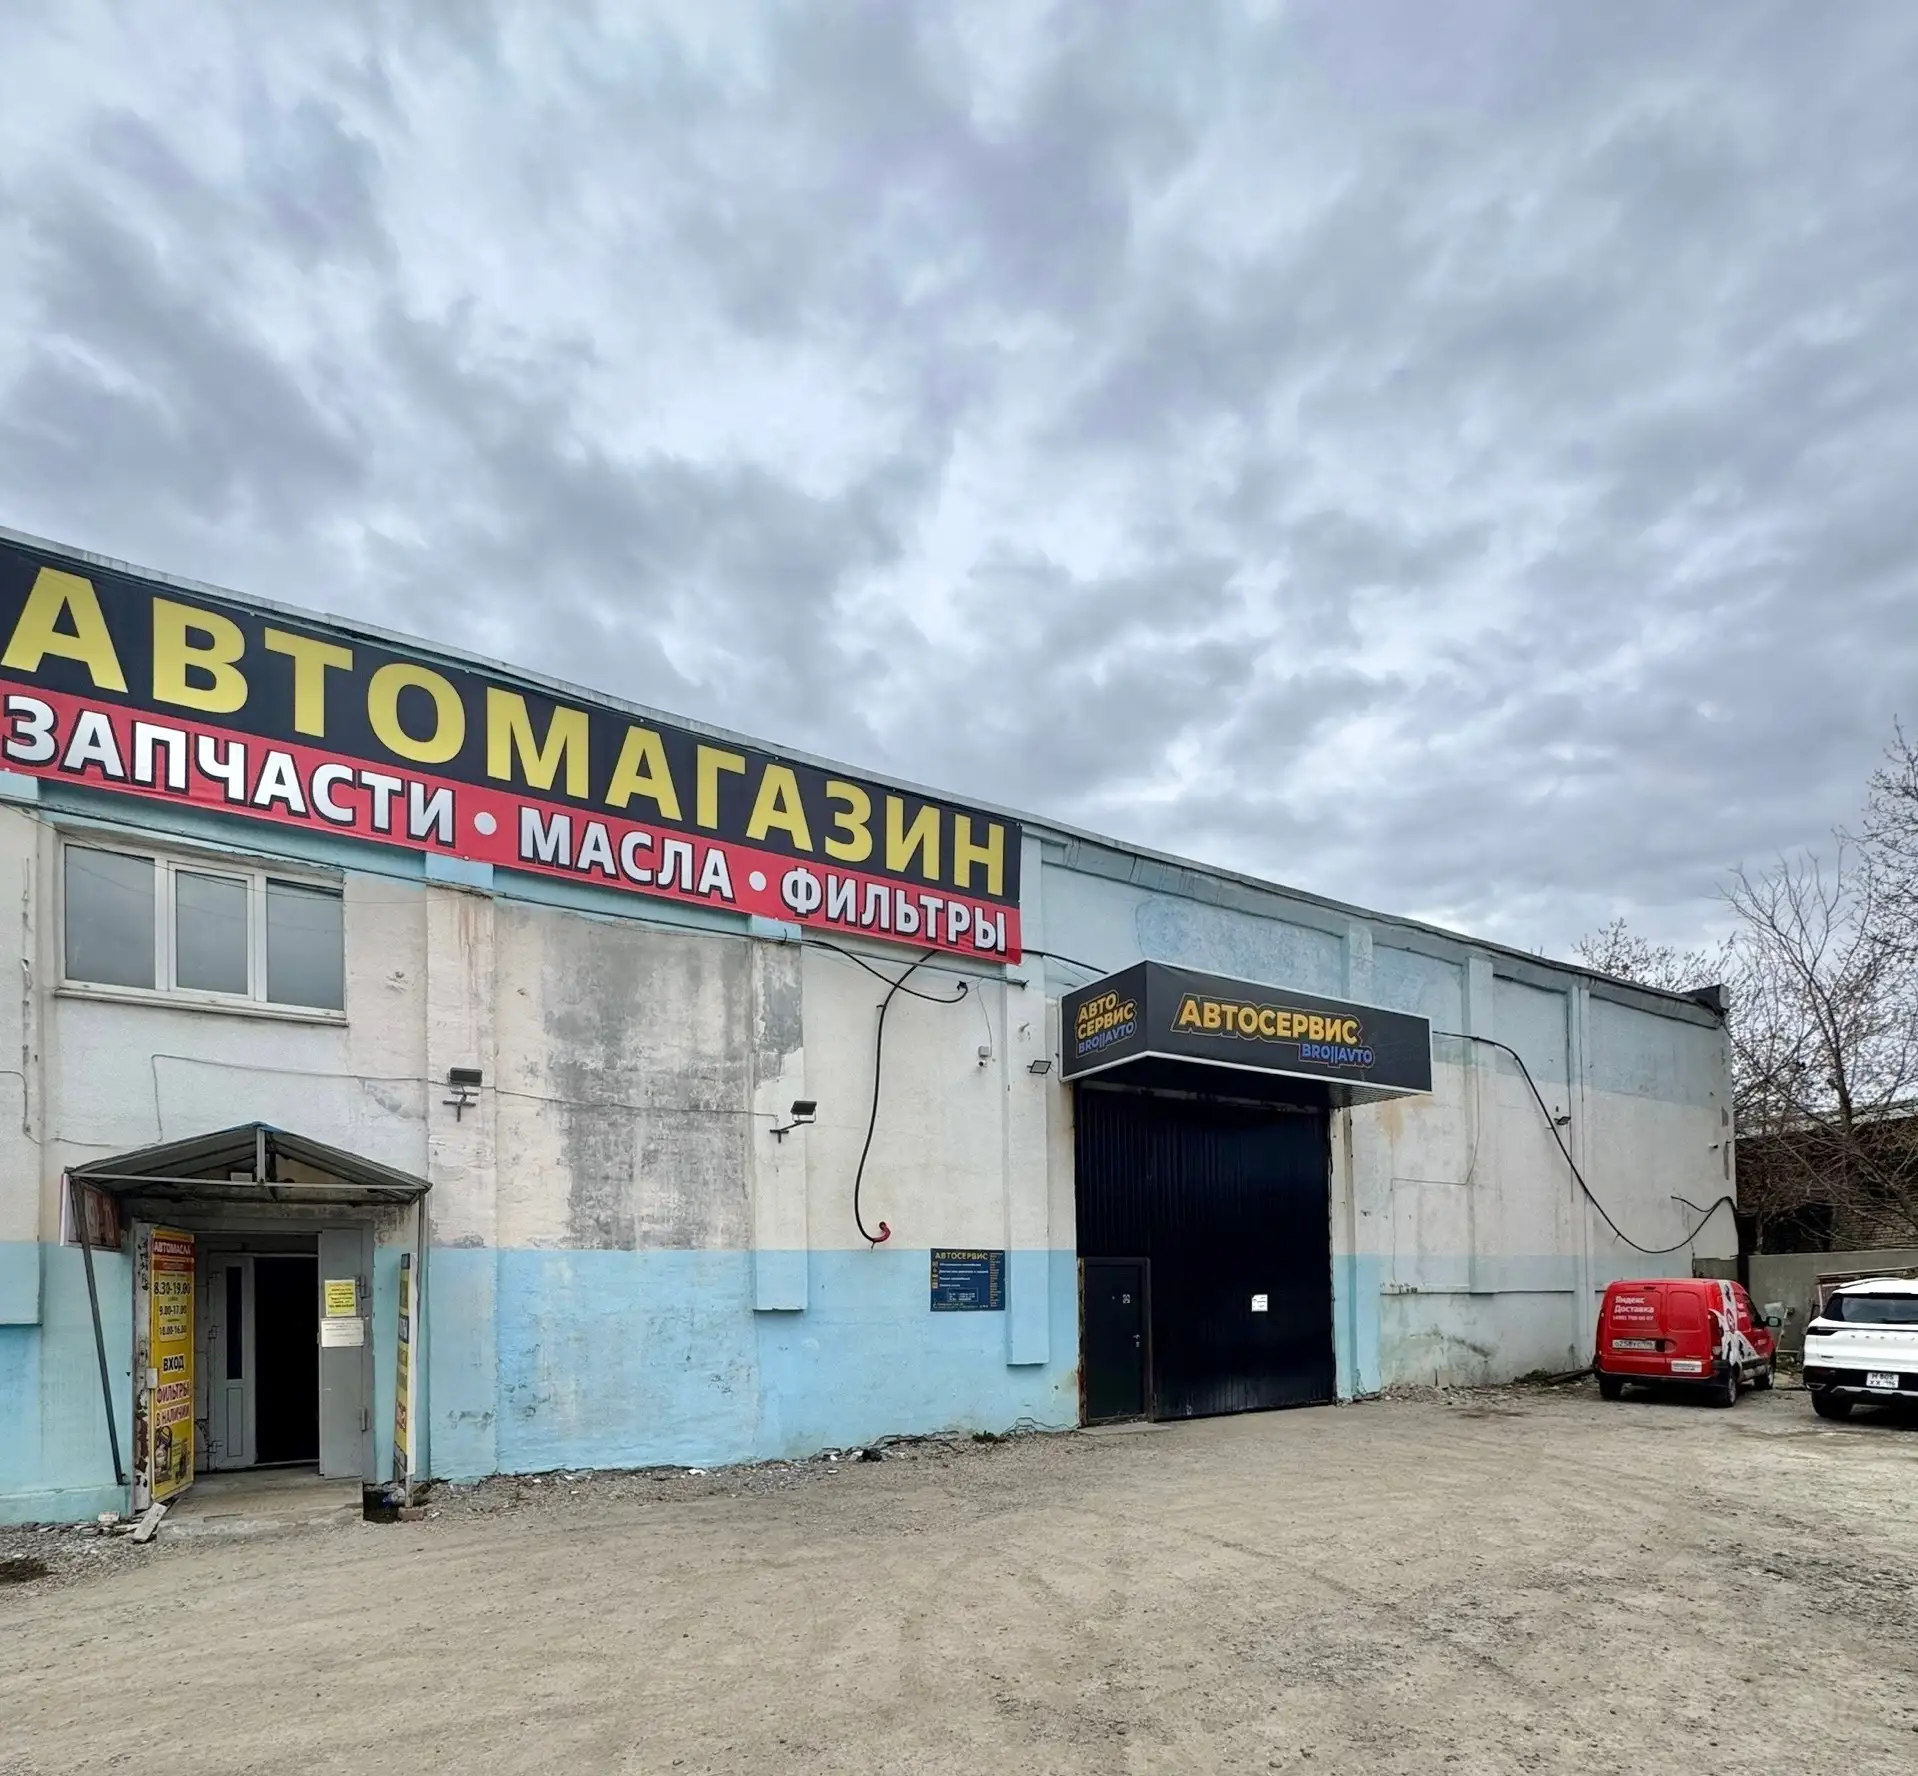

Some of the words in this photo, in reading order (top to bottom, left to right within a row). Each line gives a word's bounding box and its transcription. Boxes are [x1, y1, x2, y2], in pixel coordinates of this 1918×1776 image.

[1, 566, 1005, 896] АВТОМАГАЗИН
[4, 694, 456, 847] ЗАПЧАСТИ
[518, 806, 735, 900] МАСЛА
[780, 866, 1007, 953] ФИЛЬТРЫ
[1077, 1003, 1134, 1040] СЕРВИС
[1078, 993, 1117, 1023] АВТО
[1178, 999, 1358, 1045] АВТОСЕРВИС
[935, 1252, 988, 1260] АВТОСЕРВИС
[1614, 1305, 1655, 1313] Доставка
[1615, 1296, 1645, 1304] Яндекс
[163, 1355, 185, 1372] ВХОД
